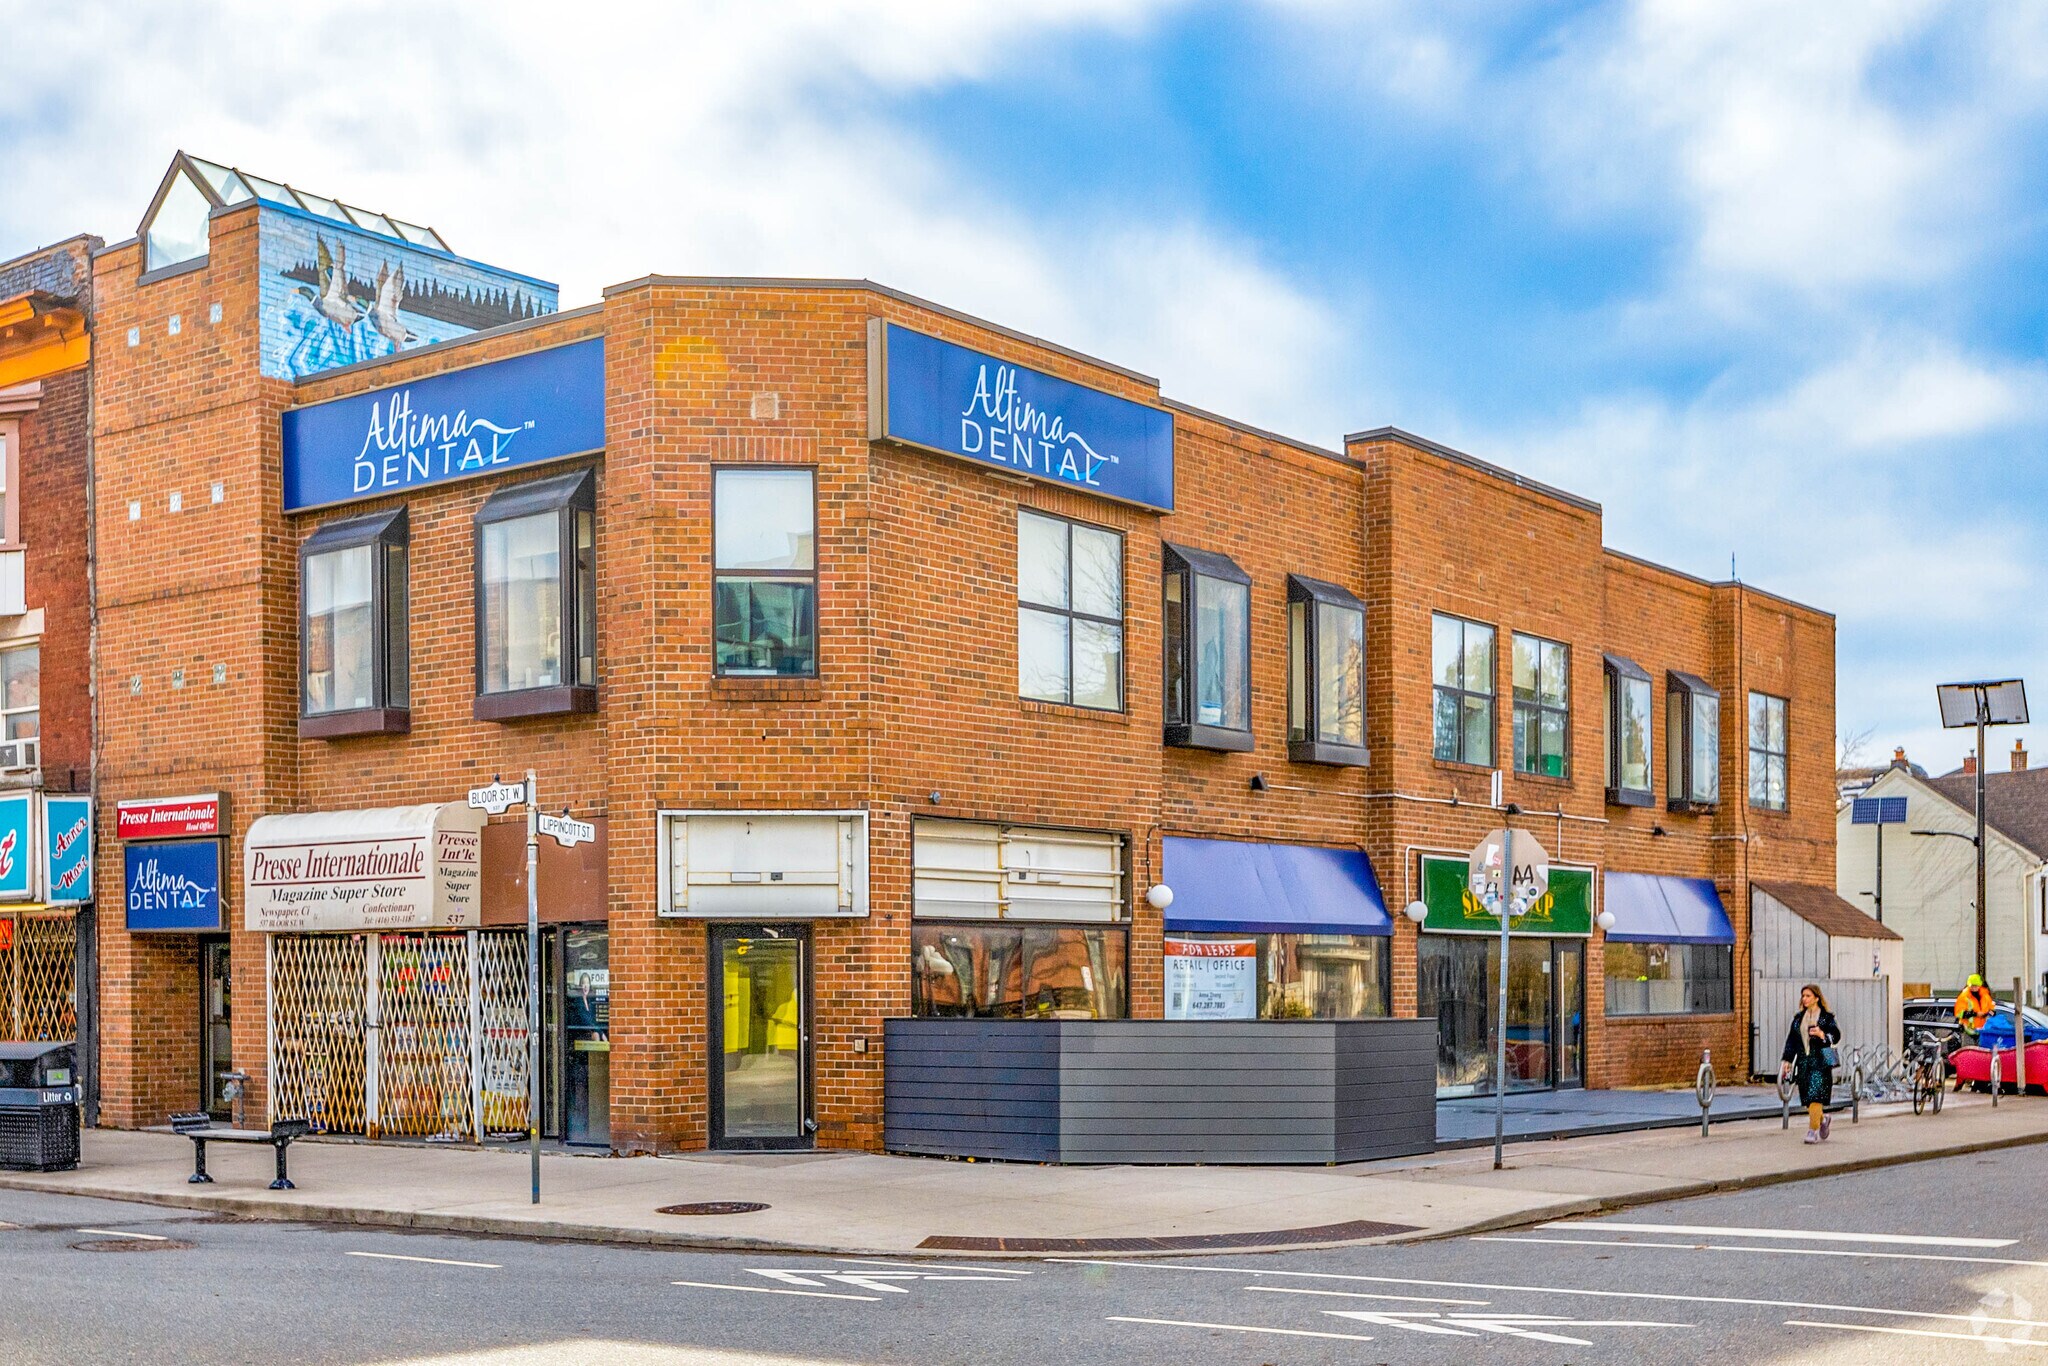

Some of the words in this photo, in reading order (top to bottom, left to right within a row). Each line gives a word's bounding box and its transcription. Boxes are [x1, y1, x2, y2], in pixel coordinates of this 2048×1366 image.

[962, 364, 1109, 461] Altima
[355, 390, 522, 460] Altima
[961, 418, 1100, 486] DENTAL
[353, 434, 510, 493] DENTAL
[471, 789, 498, 804] BLOOR
[119, 810, 149, 825] Presse
[150, 804, 215, 823] Internationale
[185, 823, 199, 831] Head
[199, 822, 215, 831] Office
[543, 817, 582, 837] LIPPINCOTT
[52, 817, 88, 859] Annex
[438, 833, 478, 846] Presse
[441, 847, 475, 860] Int'le
[251, 851, 302, 881] Presse
[304, 842, 424, 879] Internationale
[52, 854, 89, 890] Mart
[130, 858, 210, 894] Altima
[438, 867, 479, 878] Magazine
[445, 881, 471, 892] Super
[130, 890, 206, 910] DENTAL
[269, 887, 328, 905] Magazine
[330, 885, 369, 903] Super
[371, 884, 406, 898] Store
[447, 894, 470, 903] Store
[362, 902, 416, 915] Confectionary
[446, 914, 465, 925] 537
[1182, 944, 1203, 955] FOR
[1205, 944, 1236, 956] LEASE
[1173, 959, 1203, 970] RETAIL
[1212, 960, 1245, 971] OFFICE
[591, 973, 606, 982] FOR
[43, 1091, 62, 1103] Litter
